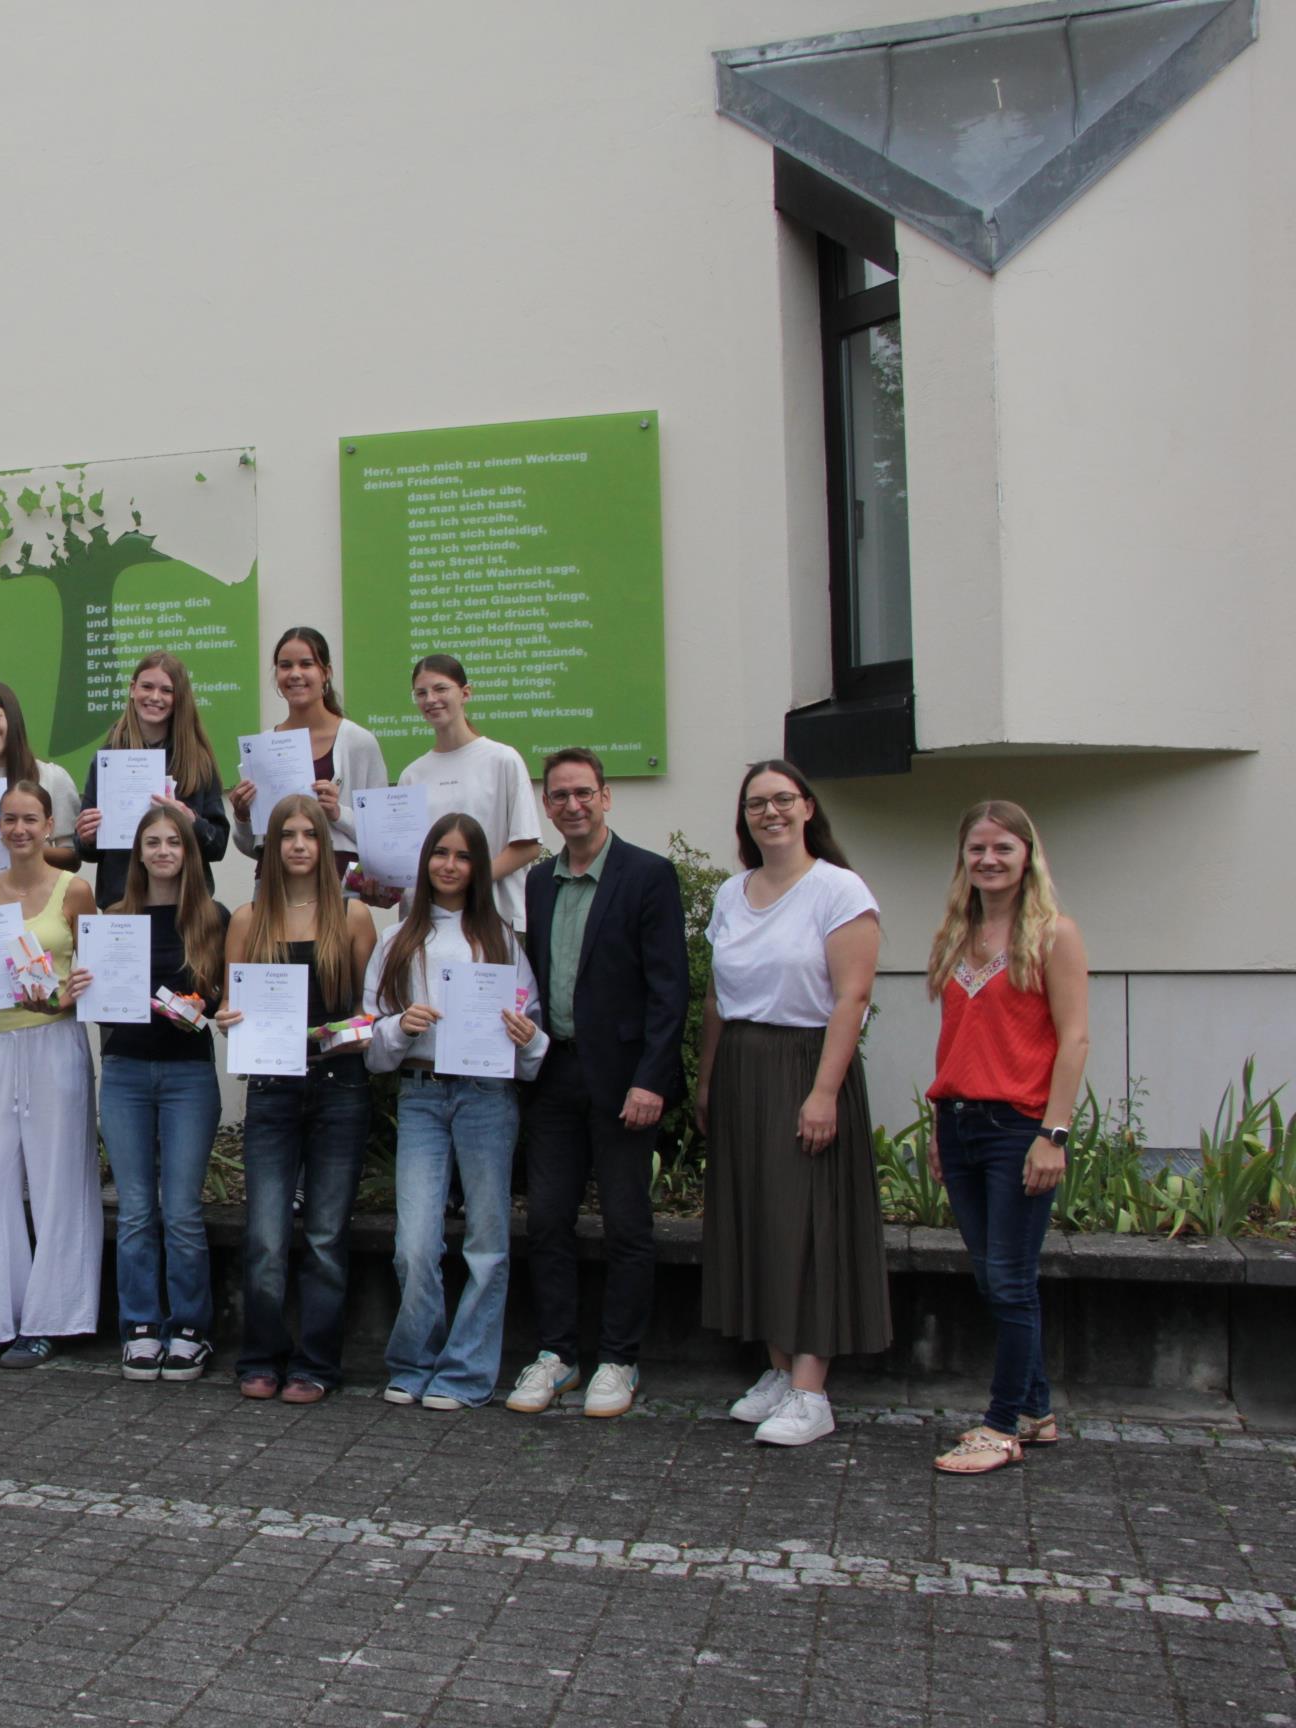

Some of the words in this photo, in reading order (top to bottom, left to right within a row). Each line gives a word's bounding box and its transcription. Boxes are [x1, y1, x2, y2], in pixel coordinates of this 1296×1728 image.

[364, 468, 393, 476] Herr,
[397, 464, 430, 474] mach
[433, 461, 463, 471] mich
[467, 461, 481, 469] zu
[484, 458, 522, 467] einem
[526, 452, 588, 463] Werkzeug
[364, 480, 404, 490] deines
[407, 476, 463, 486] Friedens,
[408, 493, 436, 502] dass
[440, 490, 458, 499] ich
[461, 488, 496, 498] Liebe
[499, 486, 526, 495] übe,
[408, 507, 426, 515] wo
[429, 505, 455, 513] man
[459, 501, 485, 511] sich
[487, 499, 526, 509] hasst,
[408, 520, 436, 529] dass
[441, 517, 459, 526] ich
[462, 513, 518, 524] verzeihe,
[408, 534, 426, 542] wo
[430, 532, 456, 540] man
[460, 529, 486, 538] sich
[488, 525, 547, 536] beleidigt,
[409, 547, 437, 556] dass
[440, 544, 460, 553] ich
[464, 540, 520, 552] verbinde,
[409, 560, 424, 569] da
[428, 560, 446, 568] wo
[449, 556, 485, 566] Streit
[486, 555, 507, 564] ist,
[409, 573, 438, 582] dass
[441, 571, 461, 580] ich
[463, 570, 482, 579] die
[486, 565, 542, 577] Wahrheit
[546, 565, 579, 575] sage,
[409, 588, 429, 596] wo
[431, 586, 451, 594] der
[455, 584, 494, 593] Irrtum
[496, 579, 554, 590] herrscht,
[86, 605, 107, 614] Der
[113, 603, 140, 612] Herr
[144, 601, 181, 612] segne
[185, 597, 211, 607] dich
[410, 600, 438, 610] dass
[442, 598, 461, 607] ich
[464, 598, 489, 606] den
[491, 594, 542, 605] Glauben
[545, 592, 589, 603] bringe,
[87, 618, 108, 628] und
[112, 616, 153, 627] behüte
[157, 613, 186, 623] dich.
[430, 613, 452, 622] der
[455, 609, 501, 620] Zweifel
[504, 608, 549, 618] drückt,
[87, 633, 99, 642] Er
[103, 631, 135, 642] zeige
[138, 629, 154, 639] dir
[157, 628, 182, 638] sein
[187, 625, 227, 635] Antlitz
[410, 627, 439, 636] dass
[442, 625, 461, 635] ich
[464, 624, 484, 634] die
[487, 620, 544, 634] Hoffnung
[548, 619, 593, 629] wecke,
[87, 646, 108, 655] und
[166, 641, 192, 652] sich
[195, 640, 237, 649] deiner.
[411, 642, 428, 650] wo
[432, 636, 512, 648] Verzweiflung
[515, 634, 551, 646] quält,
[465, 652, 492, 661] dein
[495, 648, 527, 659] Licht
[531, 647, 587, 658] anzünde,
[87, 660, 100, 670] Er
[521, 662, 568, 673] regiert,
[87, 674, 112, 684] sein
[512, 677, 555, 687] bringe,
[88, 688, 109, 697] und
[512, 689, 554, 700] wohnt.
[88, 702, 108, 711] Der
[368, 715, 398, 724] Herr,
[471, 712, 486, 720] zu
[489, 710, 528, 719] einem
[531, 708, 593, 717] Werkzeug
[610, 743, 641, 751] Assisi
